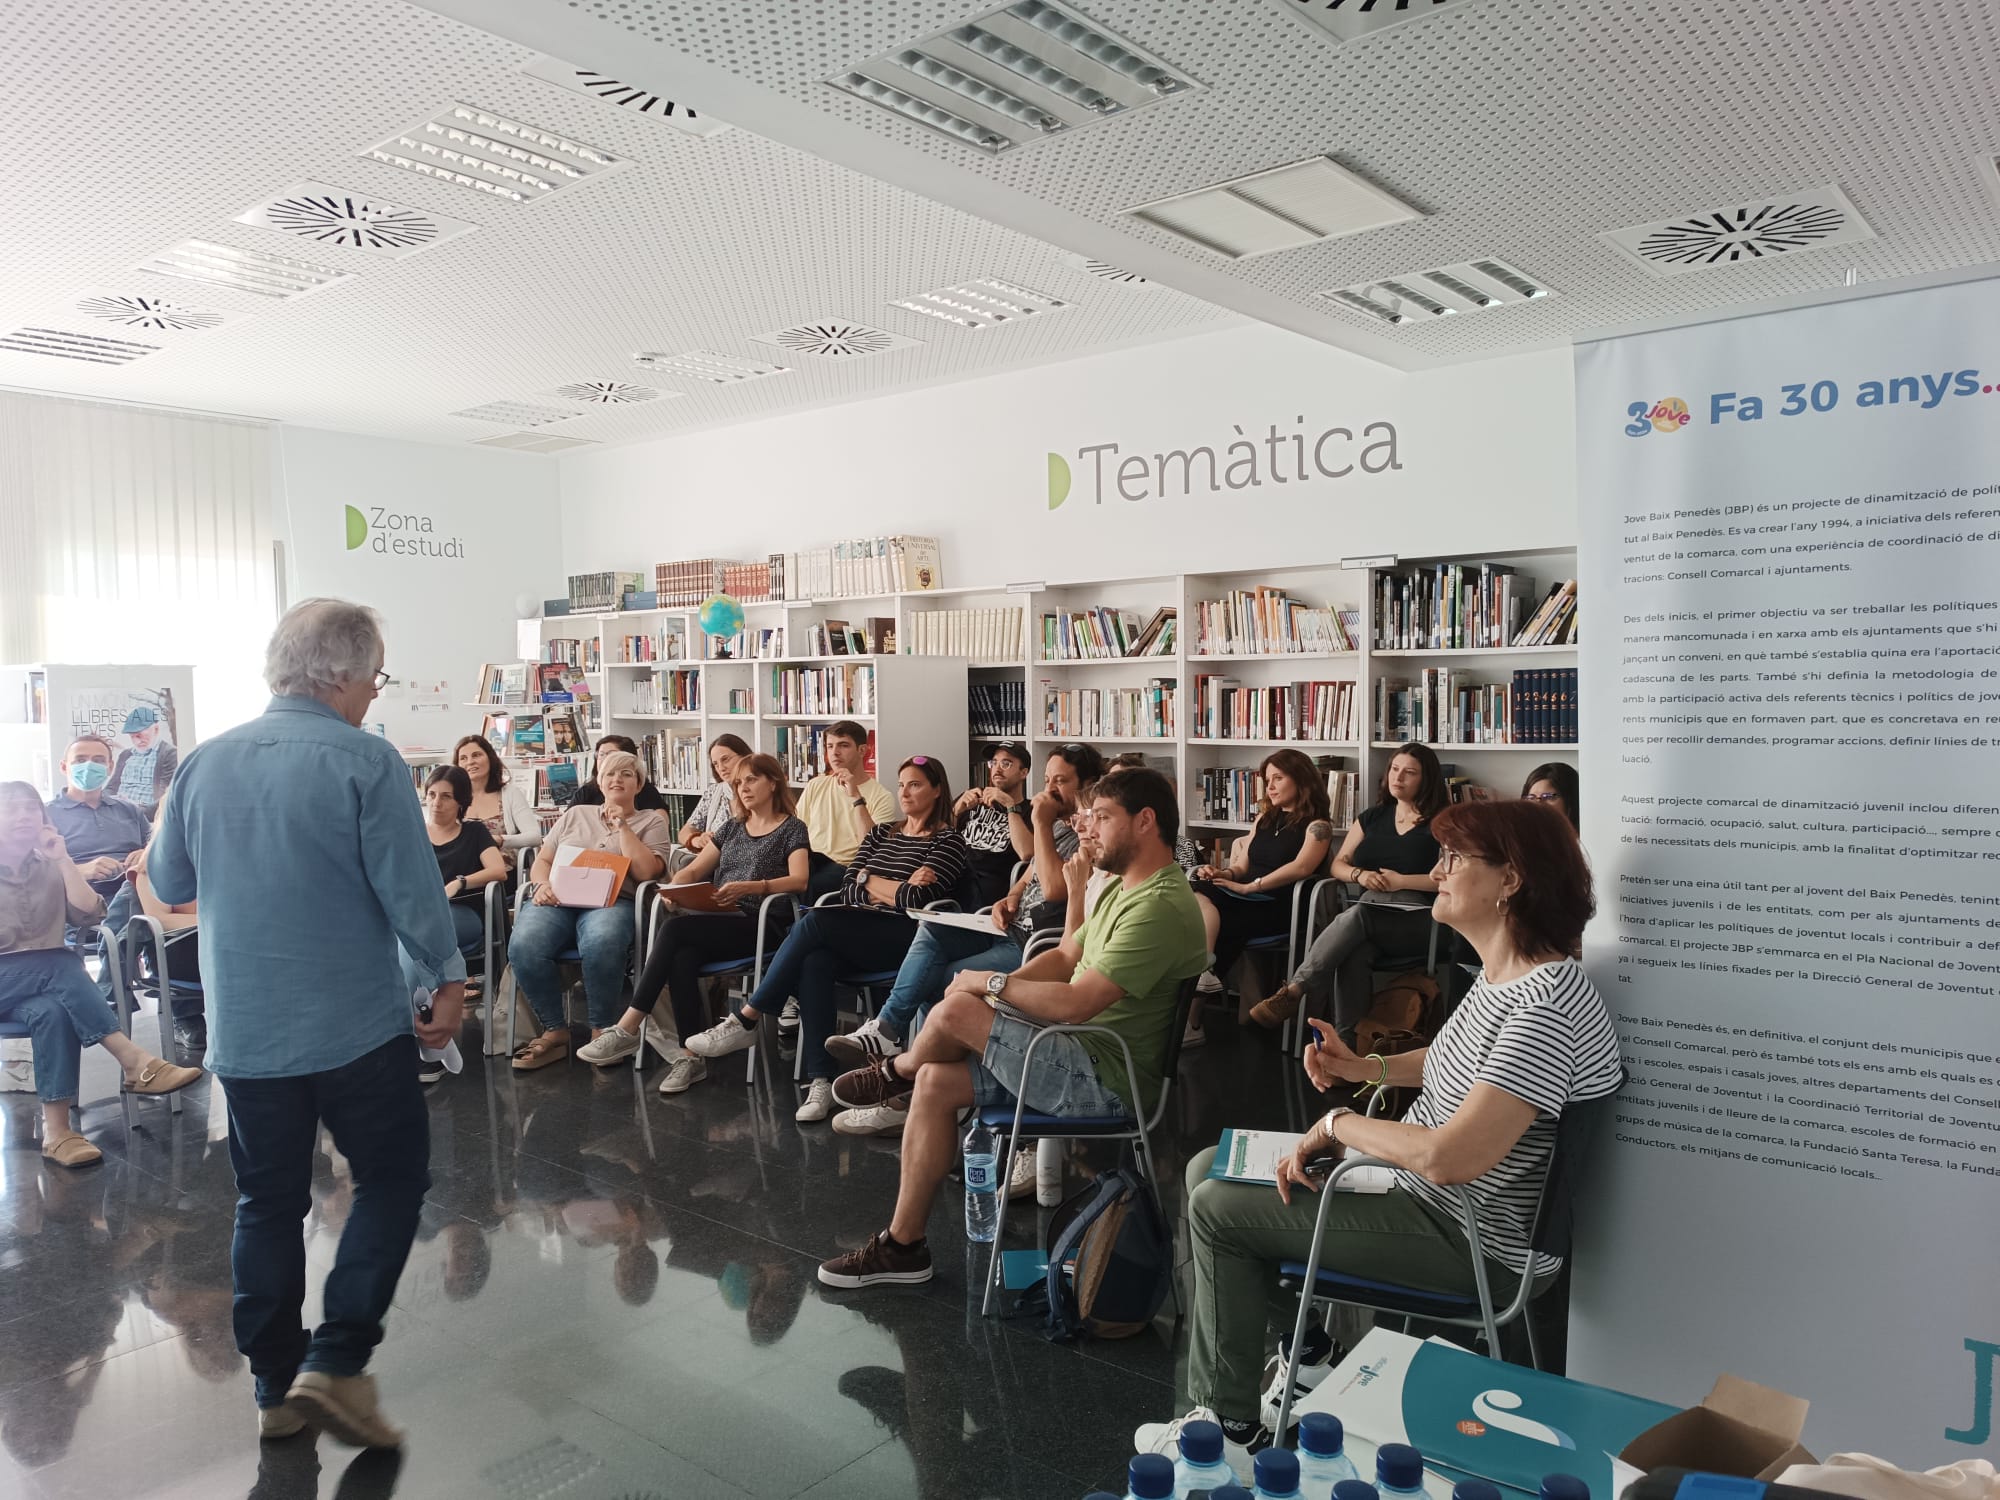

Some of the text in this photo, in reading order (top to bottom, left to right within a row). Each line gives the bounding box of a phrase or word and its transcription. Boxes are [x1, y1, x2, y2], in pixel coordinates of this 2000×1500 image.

[1710, 392, 1763, 424] Fa
[1779, 380, 1839, 416] 30
[1078, 415, 1403, 505] Temàtica
[1624, 515, 1646, 524] Jove
[1649, 512, 1670, 521] Baix
[1674, 507, 1721, 518] Penedès
[1724, 504, 1754, 515] (JBP)
[1756, 503, 1769, 512] és
[1773, 503, 1788, 511] un
[1792, 498, 1841, 511] projecte
[1844, 496, 1860, 505] de
[1864, 488, 1947, 504] dinamització
[1951, 487, 1968, 497] de
[371, 507, 433, 533] Zona
[1624, 536, 1638, 544] tut
[1641, 533, 1650, 542] al
[1652, 533, 1673, 541] Baix
[1728, 527, 1741, 536] Es
[1758, 525, 1788, 533] crear
[1791, 522, 1818, 532] l'any
[1822, 519, 1852, 529] 1994,
[1855, 519, 1863, 527] a
[1866, 514, 1922, 525] iniciativa
[1925, 512, 1951, 522] dels
[372, 532, 464, 558] d'estudi
[1623, 554, 1655, 564] ventut
[1658, 552, 1671, 561] de
[1674, 551, 1684, 559] la
[1687, 549, 1738, 559] comarca,
[1741, 548, 1767, 556] com
[1770, 546, 1792, 554] una
[1795, 540, 1864, 553] experiència
[1868, 538, 1884, 548] de
[1887, 533, 1963, 546] coordinació
[1967, 532, 1984, 542] de
[1667, 570, 1707, 580] Consell
[1710, 567, 1764, 578] Comarcal
[1774, 563, 1852, 577] ajuntaments.
[1623, 615, 1641, 624] Des
[1644, 613, 1665, 622] dels
[1669, 612, 1700, 621] inicis,
[1703, 611, 1713, 620] el
[1717, 610, 1756, 621] primer
[1760, 607, 1808, 619] objectiu
[1812, 608, 1825, 616] va
[1853, 604, 1905, 614] treballar
[1910, 603, 1928, 612] les
[1933, 601, 1998, 613] polítiques
[1678, 653, 1723, 662] conveni,
[1770, 650, 1809, 660] també
[1812, 649, 1867, 659] s'establia
[1871, 648, 1907, 659] quina
[1910, 649, 1930, 657] era
[1623, 668, 1998, 683] cadascuna de les parts. També s'hi definia la metodologia de
[72, 708, 169, 723] LLIBRES A LES
[1621, 795, 1999, 815] Aquest projecte comarcal de dinamització juvenil inclou diferen
[1768, 820, 1799, 830] salut,
[1802, 822, 1847, 832] cultura,
[1942, 828, 1991, 838] sempre
[1620, 834, 1632, 843] de
[1635, 835, 1648, 844] les
[1651, 838, 1711, 847] necessitats
[1713, 839, 1737, 848] dels
[1740, 841, 1799, 852] municipis,
[1802, 844, 1830, 853] amb
[1834, 844, 1844, 853] la
[1848, 844, 1895, 855] finalitat
[1899, 847, 1978, 859] d'optimitzar
[1618, 935, 1667, 946] comarcal.
[1670, 939, 1680, 948] El
[1683, 941, 1729, 952] projecte
[1732, 943, 1754, 953] JBP
[1756, 946, 1820, 959] s'emmarca
[1823, 953, 1839, 961] en
[1842, 953, 1853, 961] el
[1856, 953, 1875, 963] Pla
[1879, 955, 1934, 968] Nacional
[1938, 960, 1954, 970] de
[1615, 1114, 1645, 1125] grups
[1647, 1118, 1661, 1127] de
[1664, 1122, 1703, 1133] música
[1705, 1126, 1720, 1136] de
[1722, 1128, 1732, 1138] la
[1735, 1132, 1787, 1146] comarca,
[1790, 1137, 1800, 1147] la
[1803, 1140, 1859, 1155] Fundació
[1862, 1148, 1897, 1161] Santa
[1900, 1153, 1943, 1168] Teresa,
[1947, 1160, 1958, 1170] la
[1615, 1133, 1677, 1150] Conductors,
[1681, 1143, 1696, 1153] els
[1699, 1147, 1741, 1160] mitjans
[1743, 1153, 1759, 1162] de
[1761, 1157, 1837, 1174] comunicació
